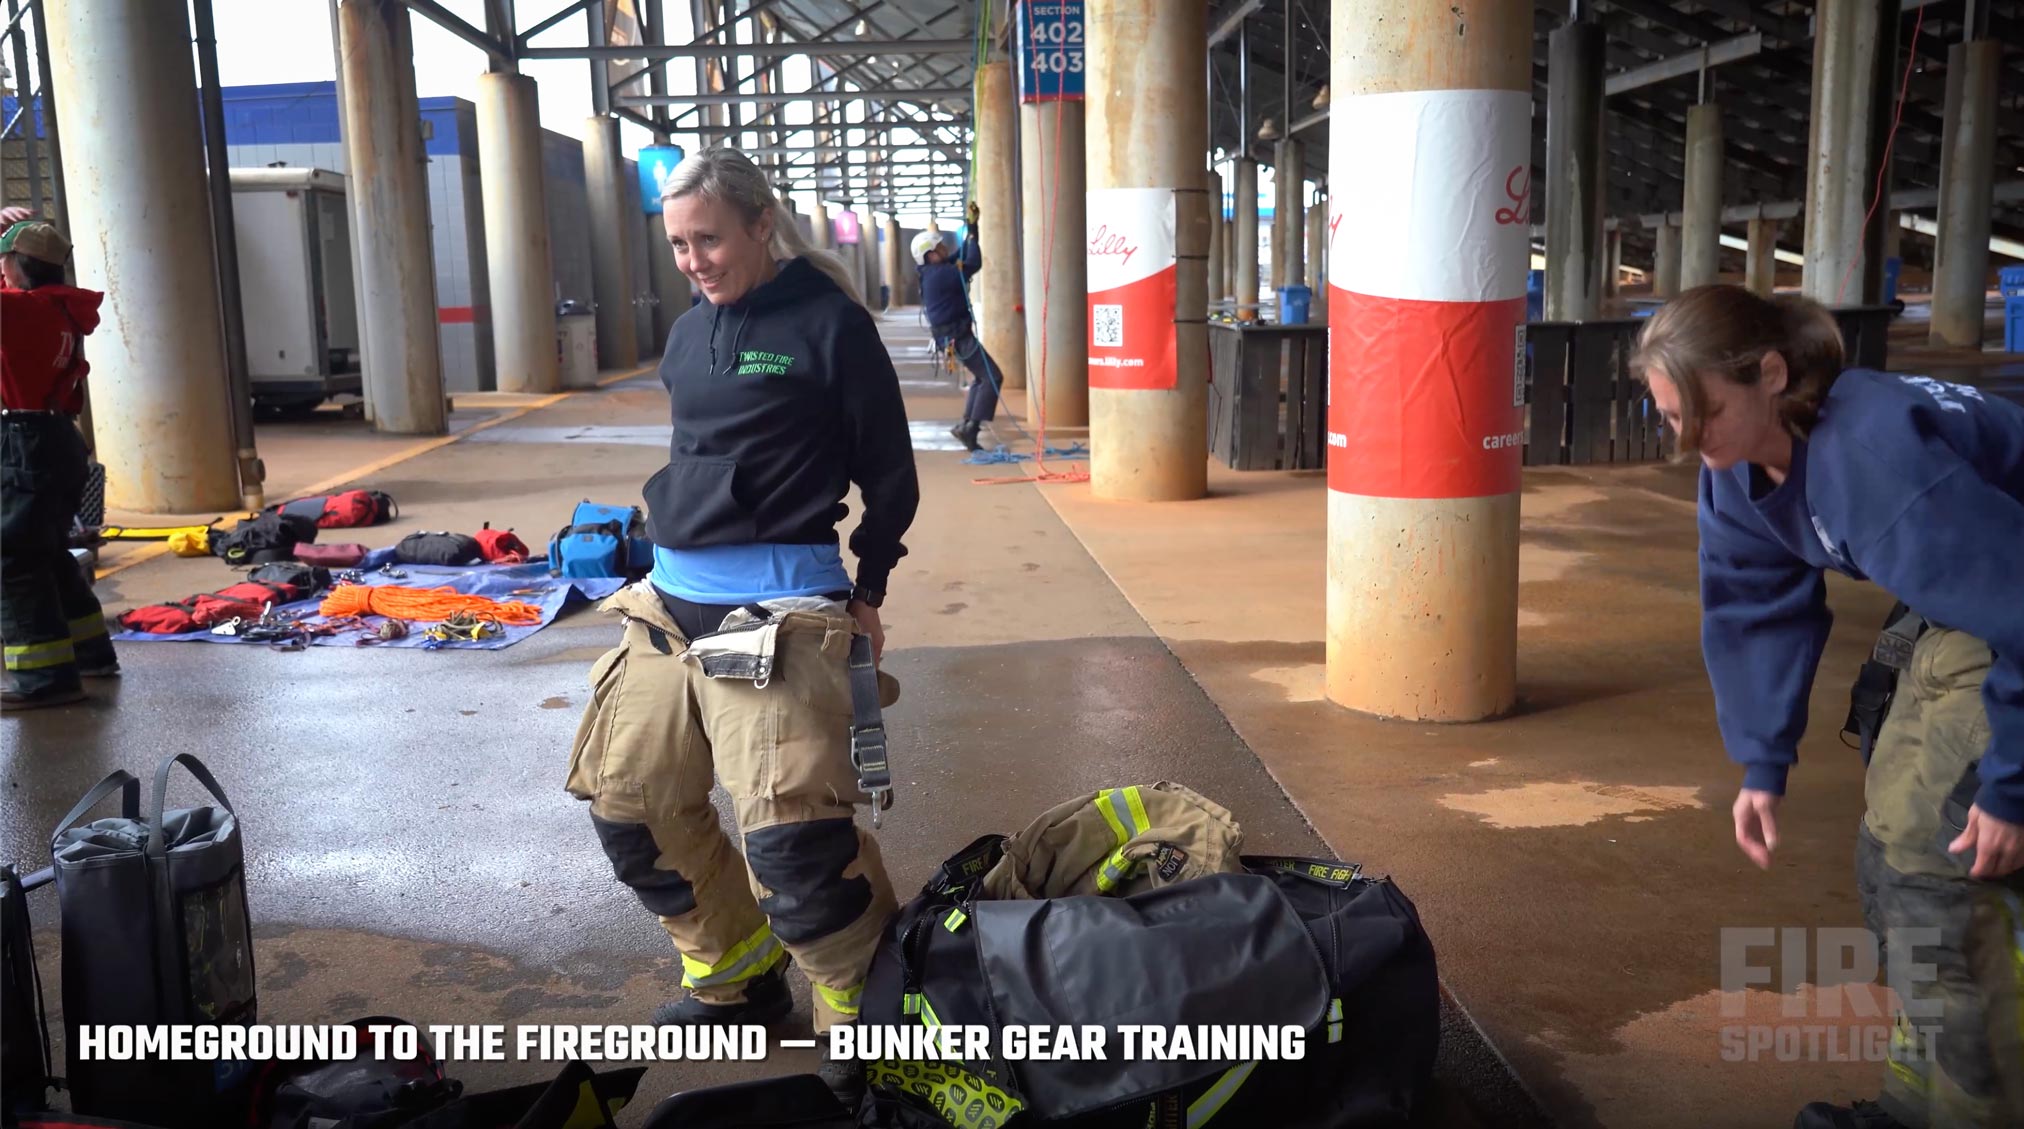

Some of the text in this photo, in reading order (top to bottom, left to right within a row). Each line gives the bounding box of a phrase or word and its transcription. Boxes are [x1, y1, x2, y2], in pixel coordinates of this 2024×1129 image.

[1034, 6, 1080, 15] SECTION
[1030, 22, 1082, 43] 402
[1031, 52, 1083, 73] 403
[740, 351, 794, 366] TWISTED FIRE
[738, 363, 787, 375] INDUSTRIES
[1162, 854, 1182, 876] LION
[1308, 864, 1330, 878] FIRE
